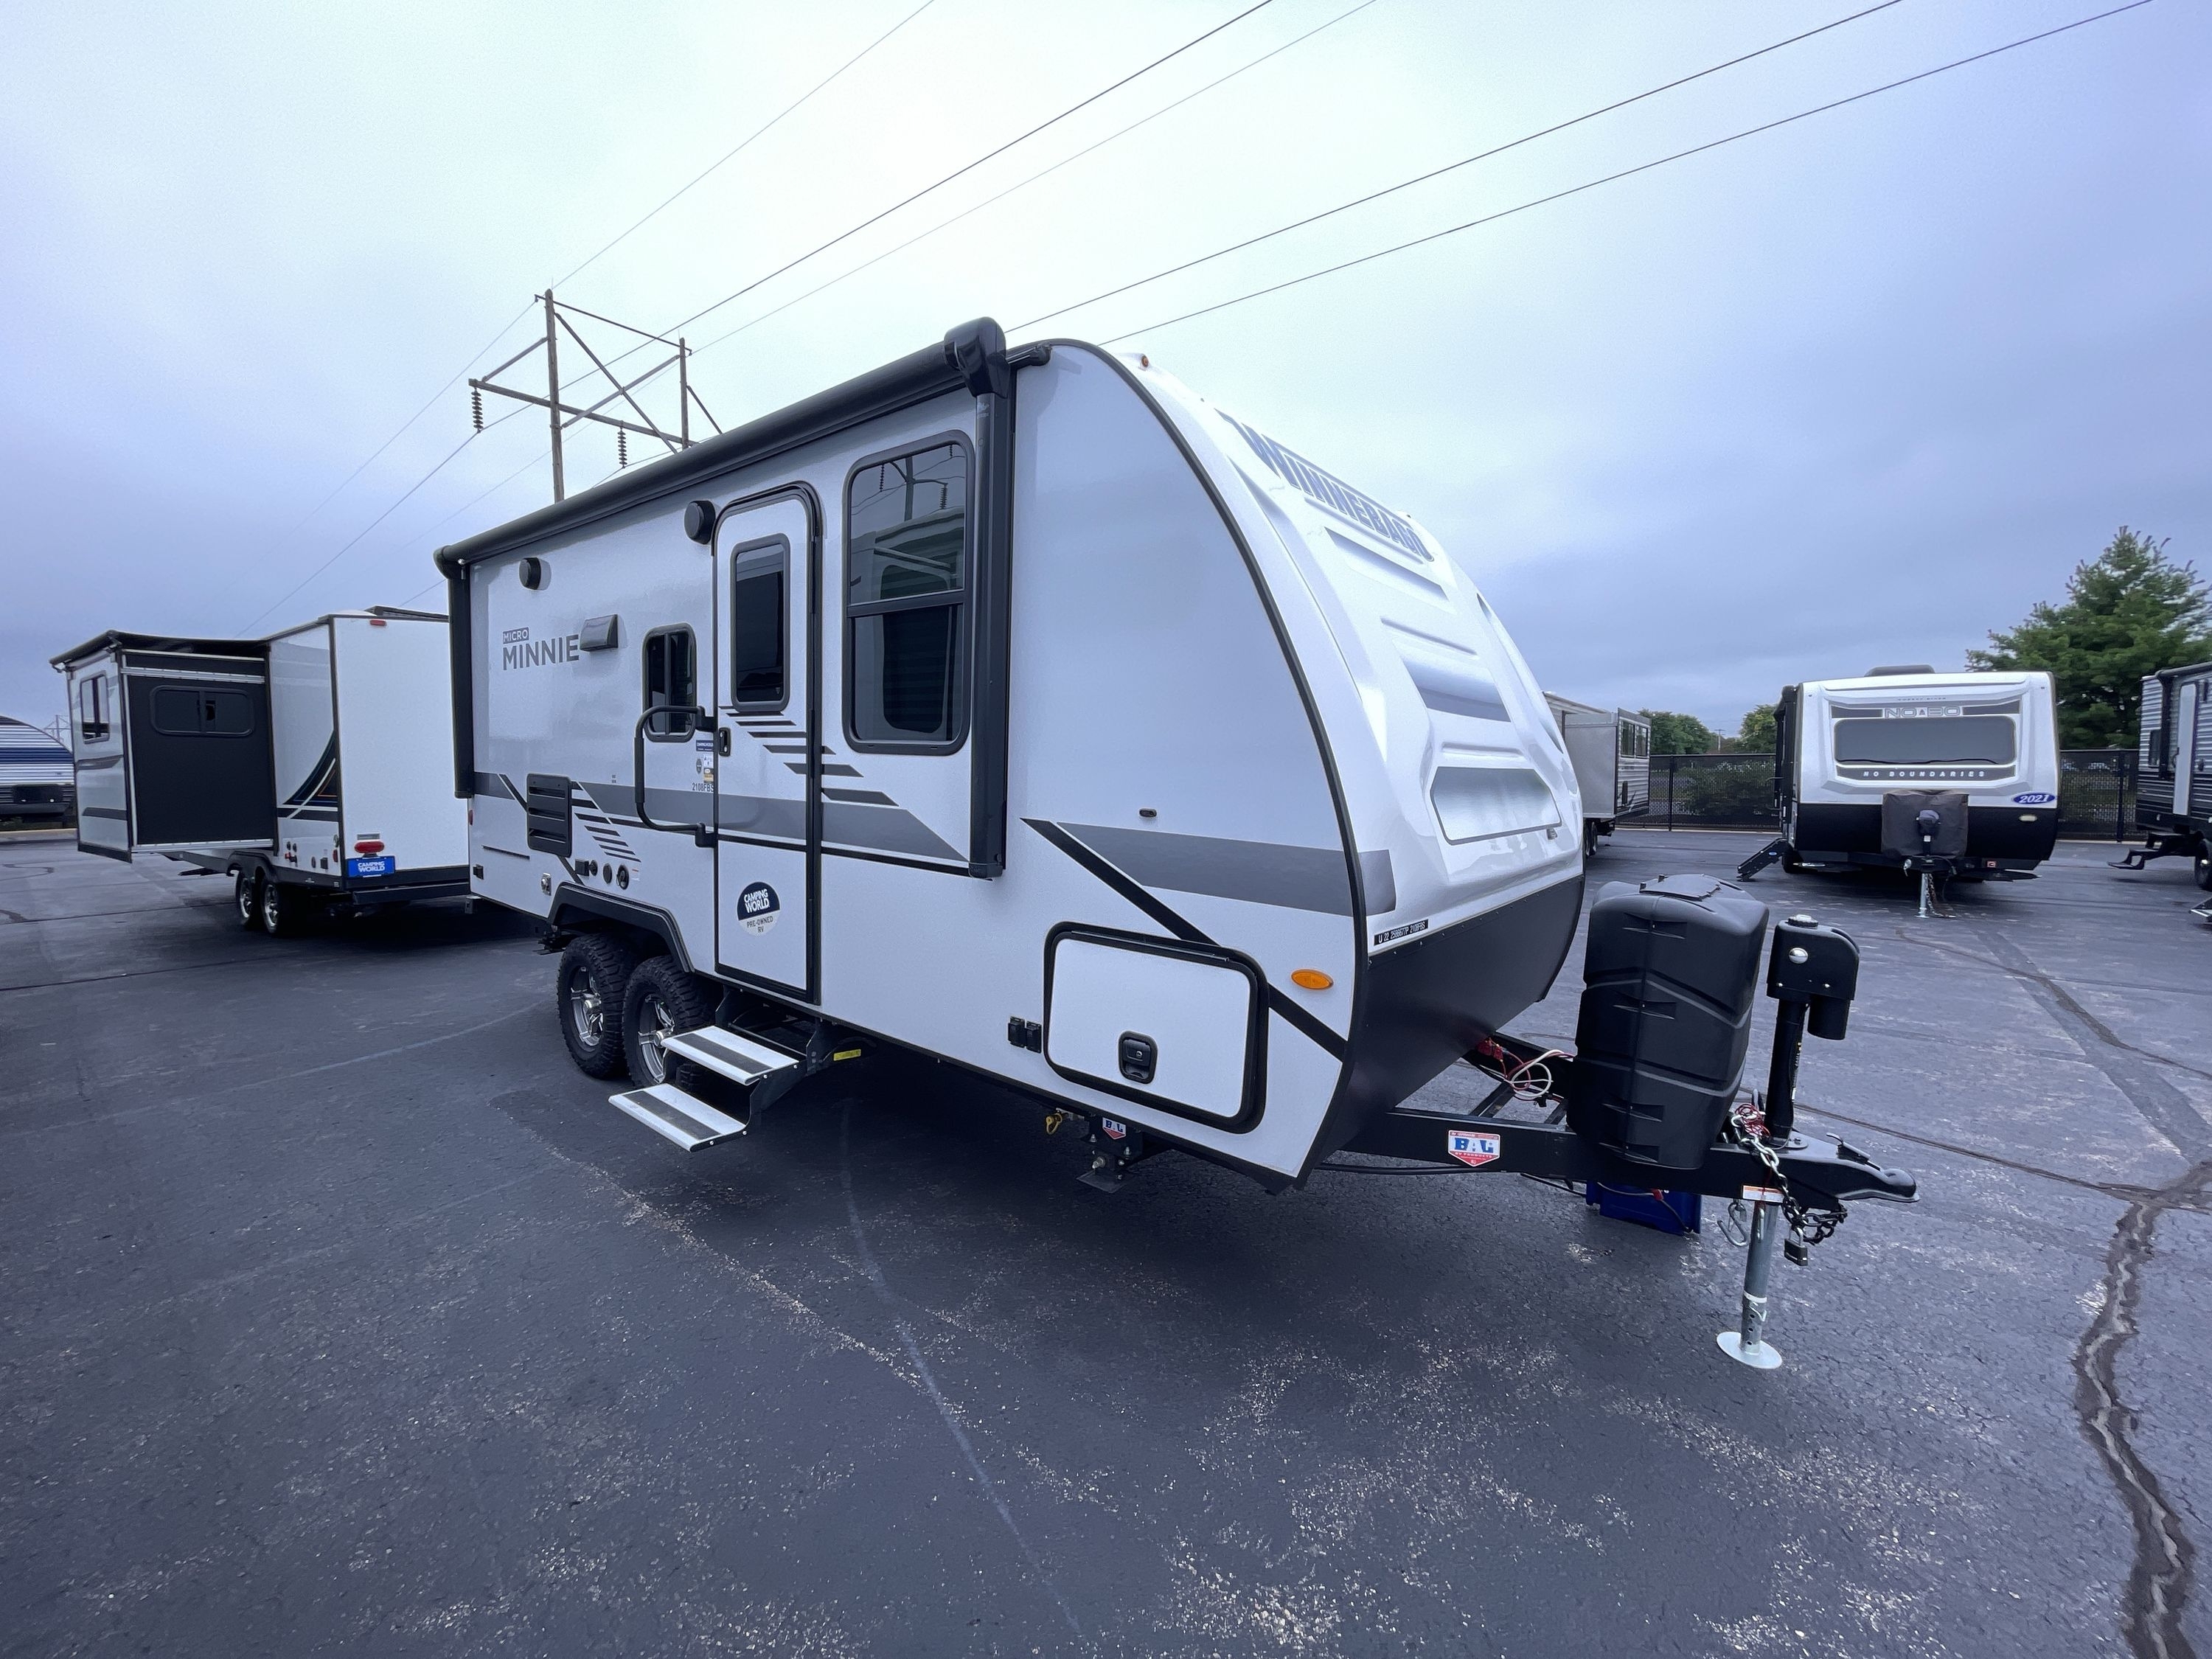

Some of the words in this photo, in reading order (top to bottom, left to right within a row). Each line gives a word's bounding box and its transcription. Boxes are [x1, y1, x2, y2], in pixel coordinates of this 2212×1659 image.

[1214, 408, 1434, 562] WINNEBAGO
[503, 629, 529, 643] MICRO
[503, 634, 580, 671] MINNIE
[2019, 794, 2050, 803] 2021
[743, 888, 769, 903] CAMPING
[745, 897, 770, 914] WORLD
[746, 915, 773, 928] PRE-OWNED
[1383, 932, 1390, 942] 22
